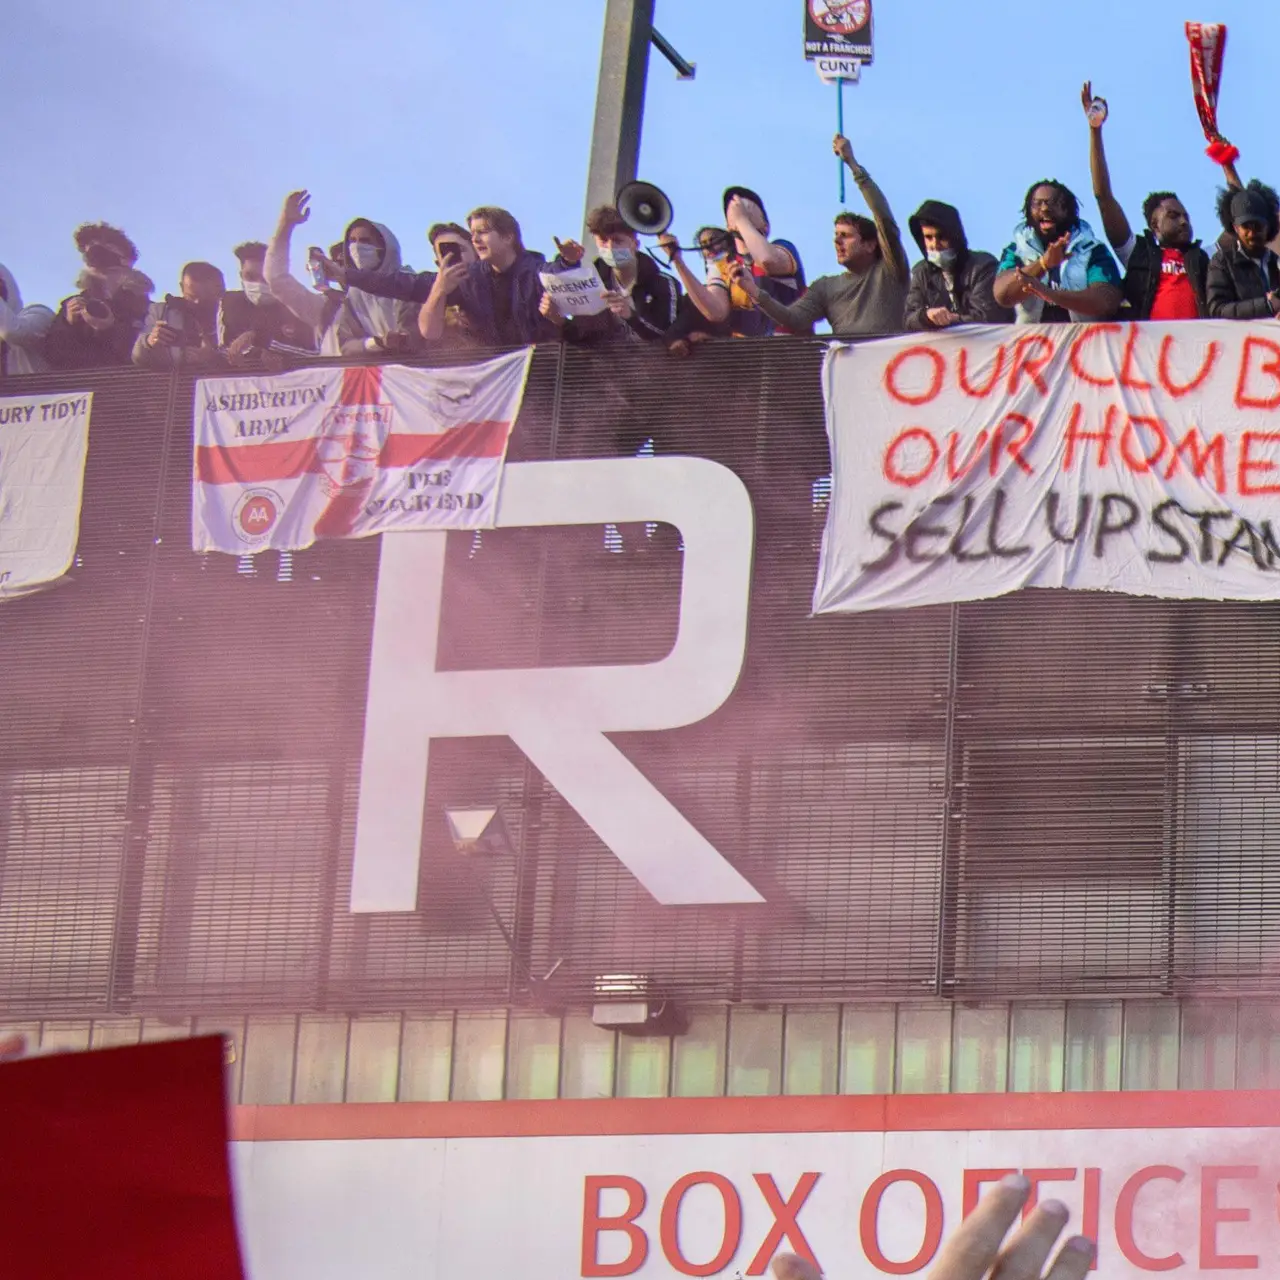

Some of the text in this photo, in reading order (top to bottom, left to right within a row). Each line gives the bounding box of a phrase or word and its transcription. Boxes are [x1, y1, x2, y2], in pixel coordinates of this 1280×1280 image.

[820, 60, 856, 73] CUNT
[566, 295, 590, 306] OUT
[883, 333, 1054, 406] OUR
[40, 398, 87, 422] TIDY!
[206, 384, 327, 413] ASHBURTON
[234, 416, 293, 438] ARMY
[883, 412, 1036, 488] OUR
[435, 492, 485, 511] END
[248, 507, 269, 524] AA
[860, 490, 1031, 573] SELL
[1044, 491, 1141, 558] UP
[580, 1170, 823, 1279] BOX
